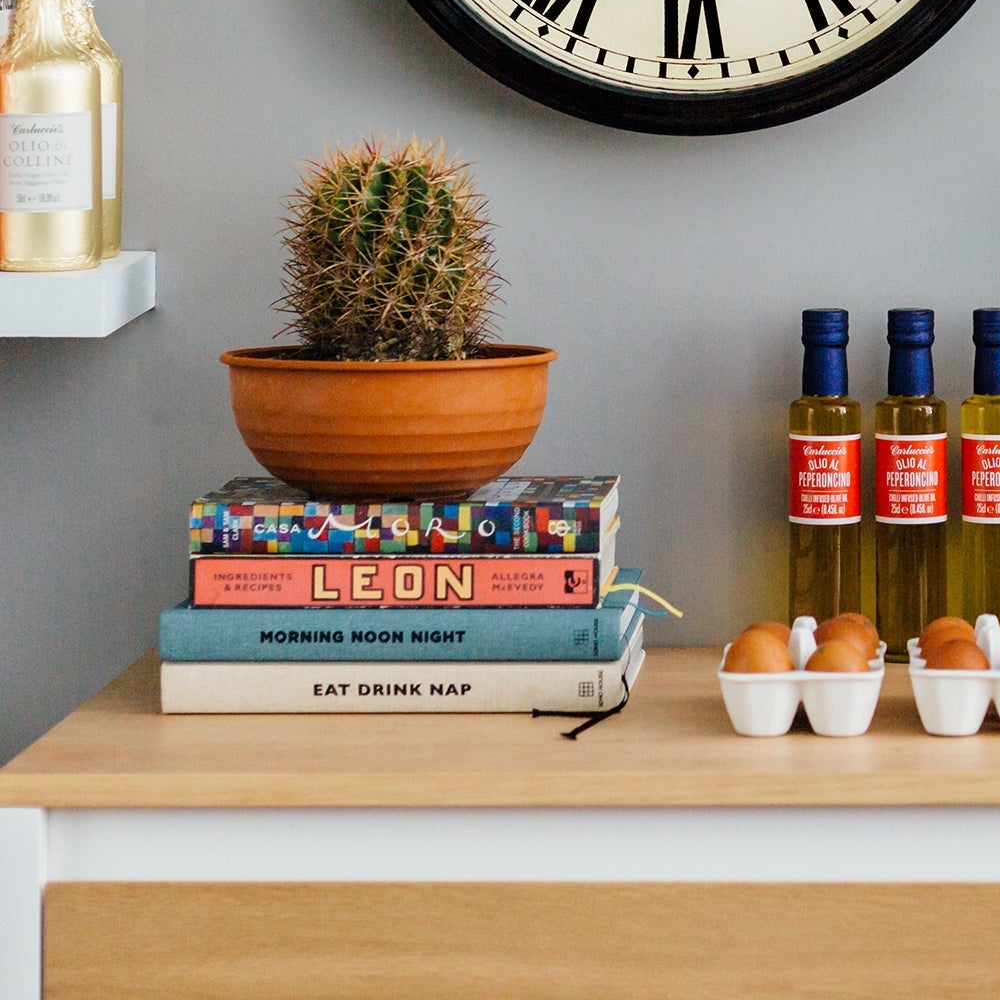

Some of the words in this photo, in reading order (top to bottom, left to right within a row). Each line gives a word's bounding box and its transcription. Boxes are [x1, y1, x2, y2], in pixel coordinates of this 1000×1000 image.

[11, 123, 63, 135] Carluccio's
[8, 140, 50, 152] OLIO
[3, 155, 73, 167] COLLINE
[803, 445, 846, 456] Carluccio's
[890, 445, 934, 456] Carluccio's
[808, 458, 828, 470] OLIO
[829, 459, 840, 470] AL
[896, 457, 916, 470] OLIO
[917, 458, 927, 470] AL
[981, 457, 1000, 470] OLIO
[798, 472, 851, 488] PEPERONCINO
[886, 471, 938, 487] PEPERONCINO
[254, 524, 301, 534] CASA
[214, 573, 292, 581] INGREDIENTS
[312, 564, 475, 601] LEON
[491, 573, 544, 581] ALLEGRA
[224, 584, 230, 592] &
[235, 584, 282, 592] RECIPES
[260, 630, 344, 644] MORNING
[351, 631, 404, 643] NOON
[411, 631, 466, 643] NIGHT
[313, 684, 350, 696] EAT
[358, 684, 422, 696] DRINK
[430, 684, 472, 696] NAP
